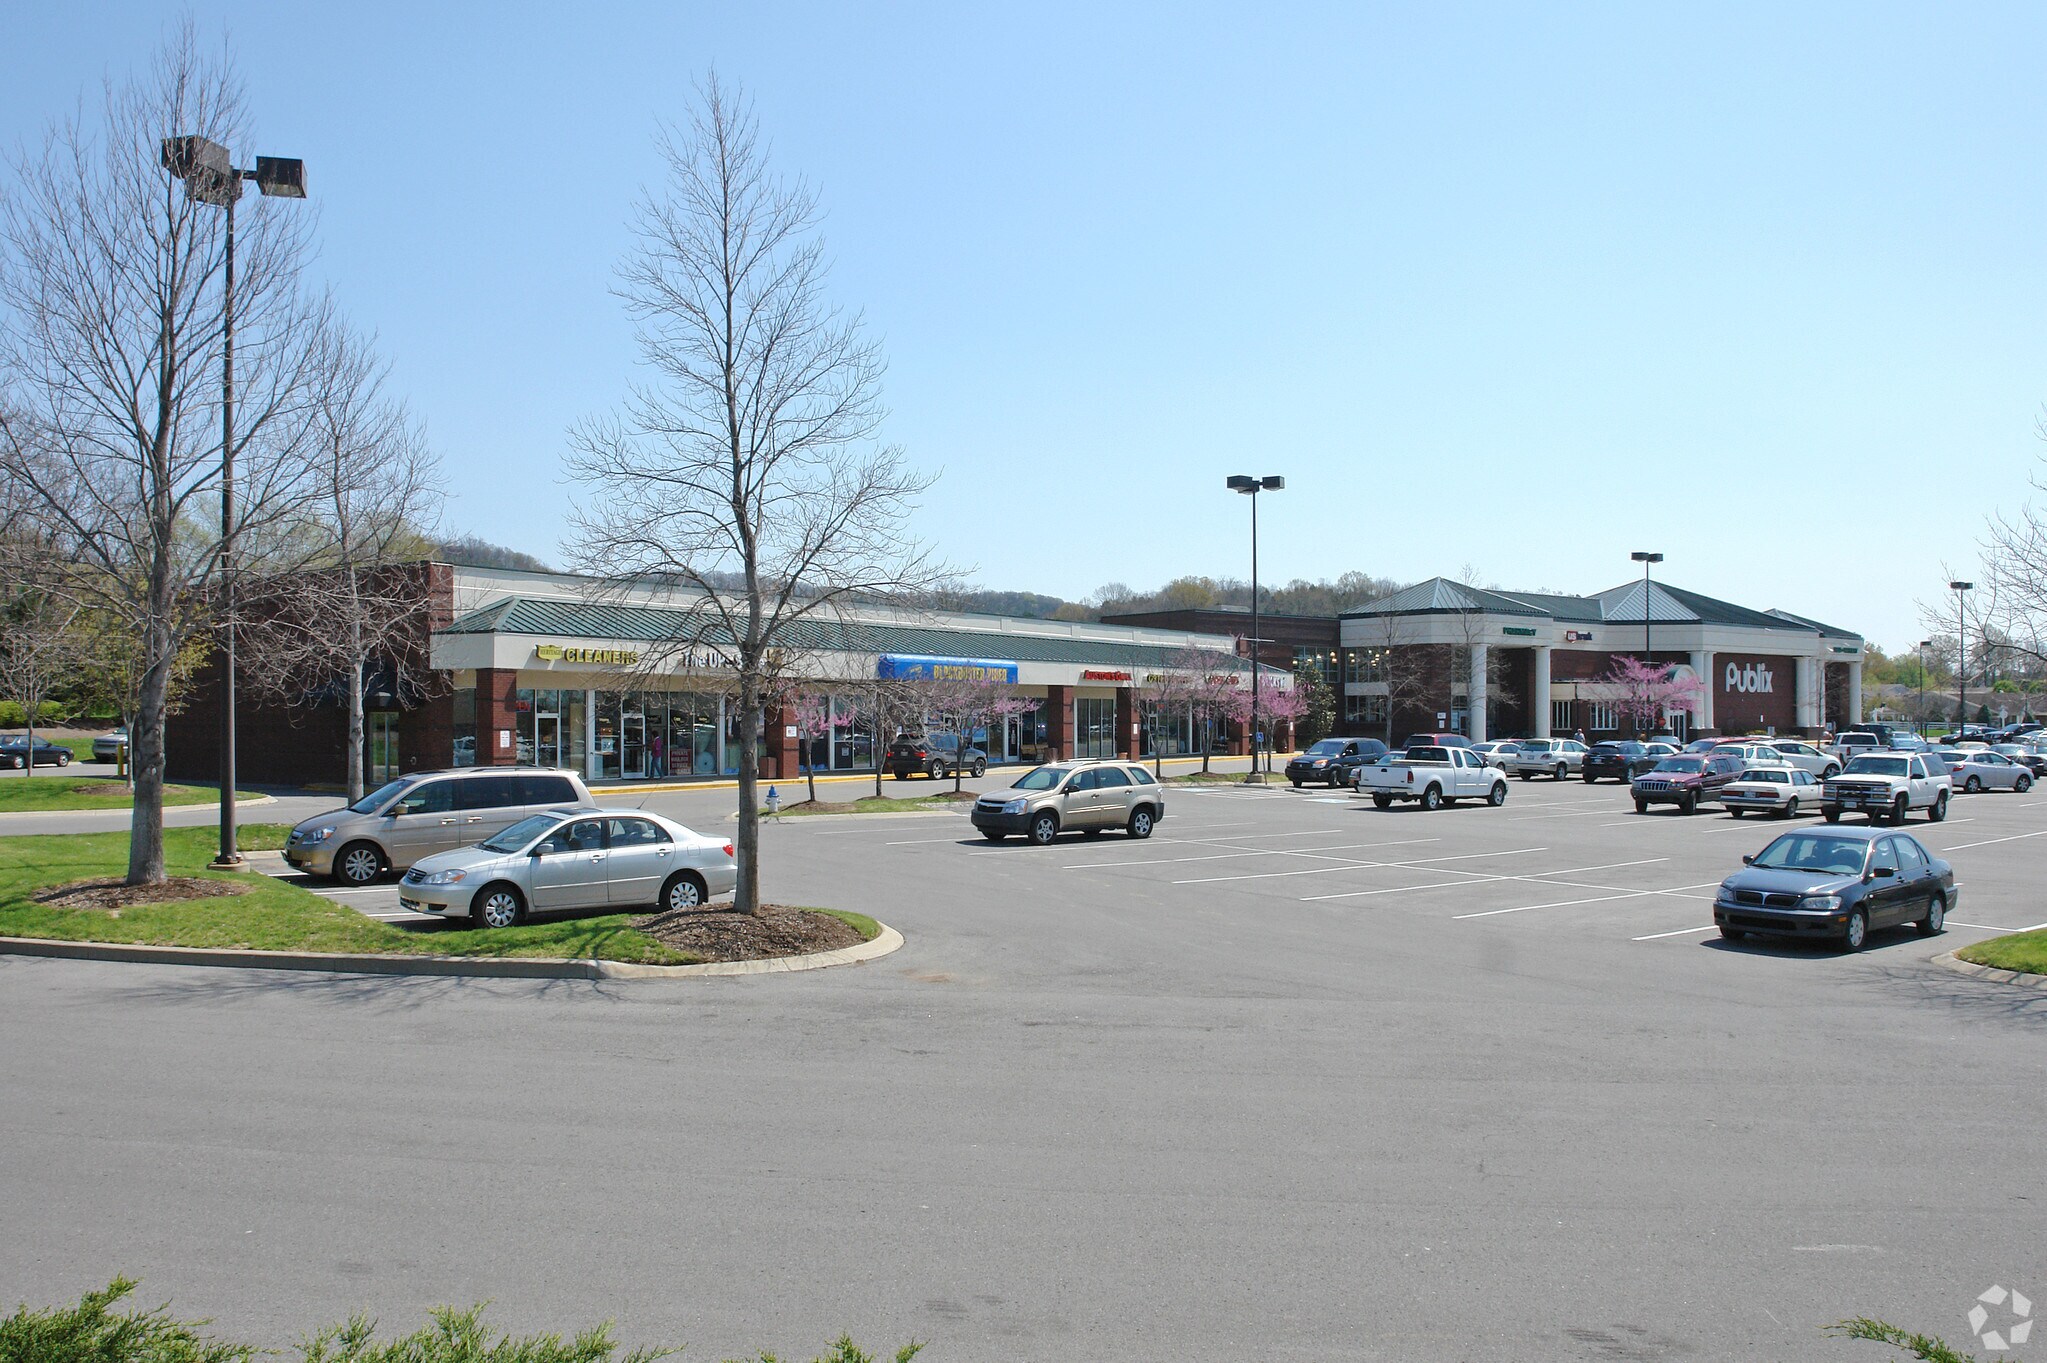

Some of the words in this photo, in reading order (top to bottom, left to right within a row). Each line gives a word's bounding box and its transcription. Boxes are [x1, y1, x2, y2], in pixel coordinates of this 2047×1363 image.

[565, 648, 638, 666] CLEANERS
[682, 650, 706, 668] The
[1725, 662, 1774, 693] Publix
